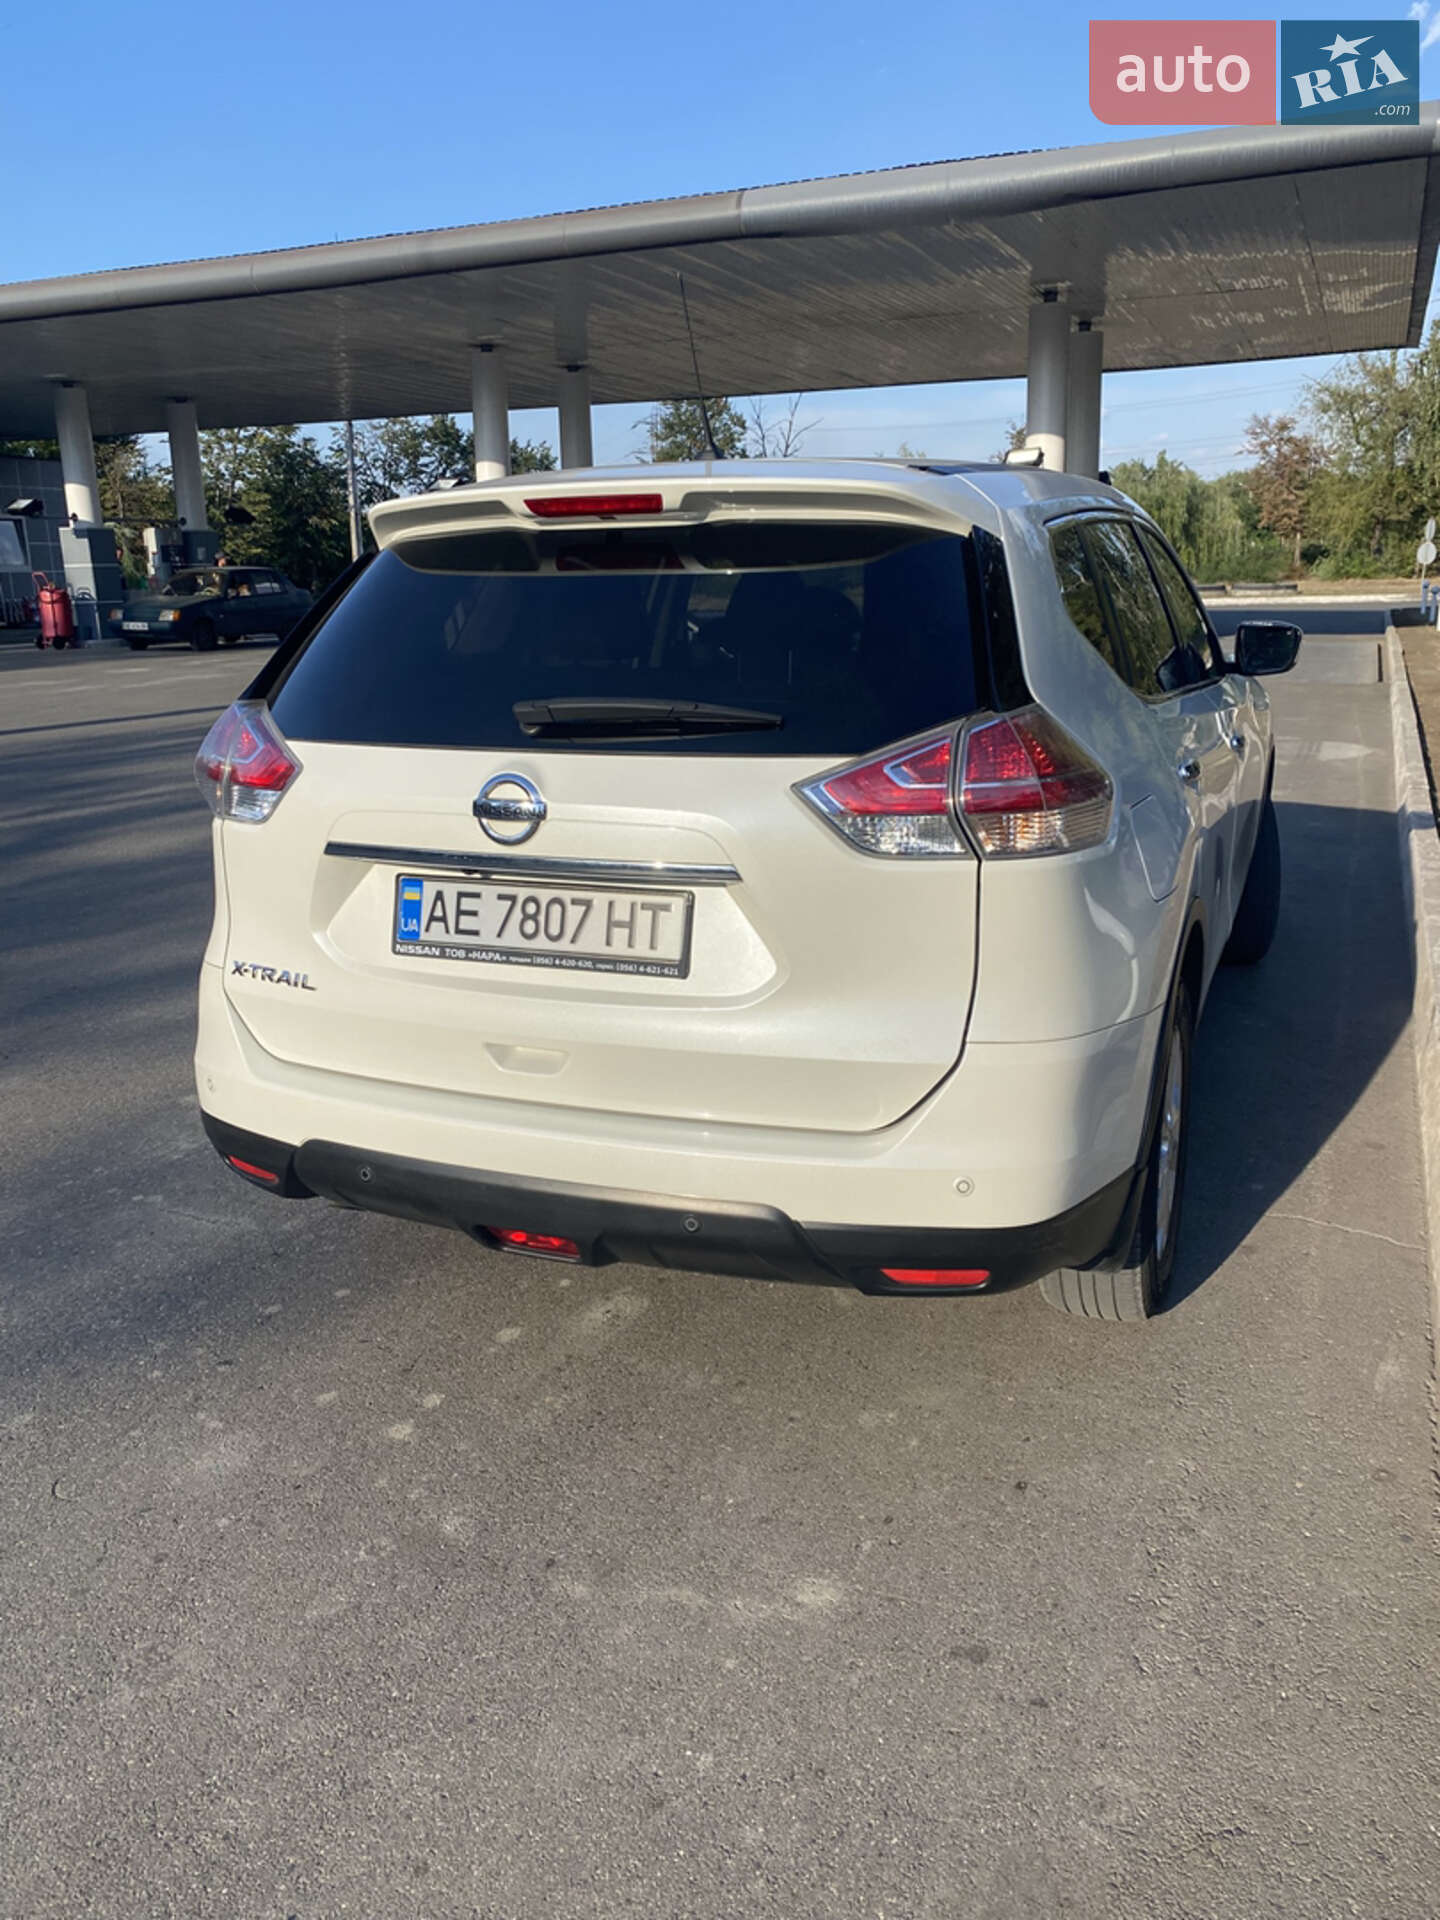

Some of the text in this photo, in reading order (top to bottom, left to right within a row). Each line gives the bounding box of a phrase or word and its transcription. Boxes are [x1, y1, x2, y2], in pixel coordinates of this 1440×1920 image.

[400, 918, 418, 932] UA
[424, 890, 672, 950] AE 7807 HT
[395, 944, 440, 956] NISSAN
[231, 960, 317, 991] X-TRAIL
